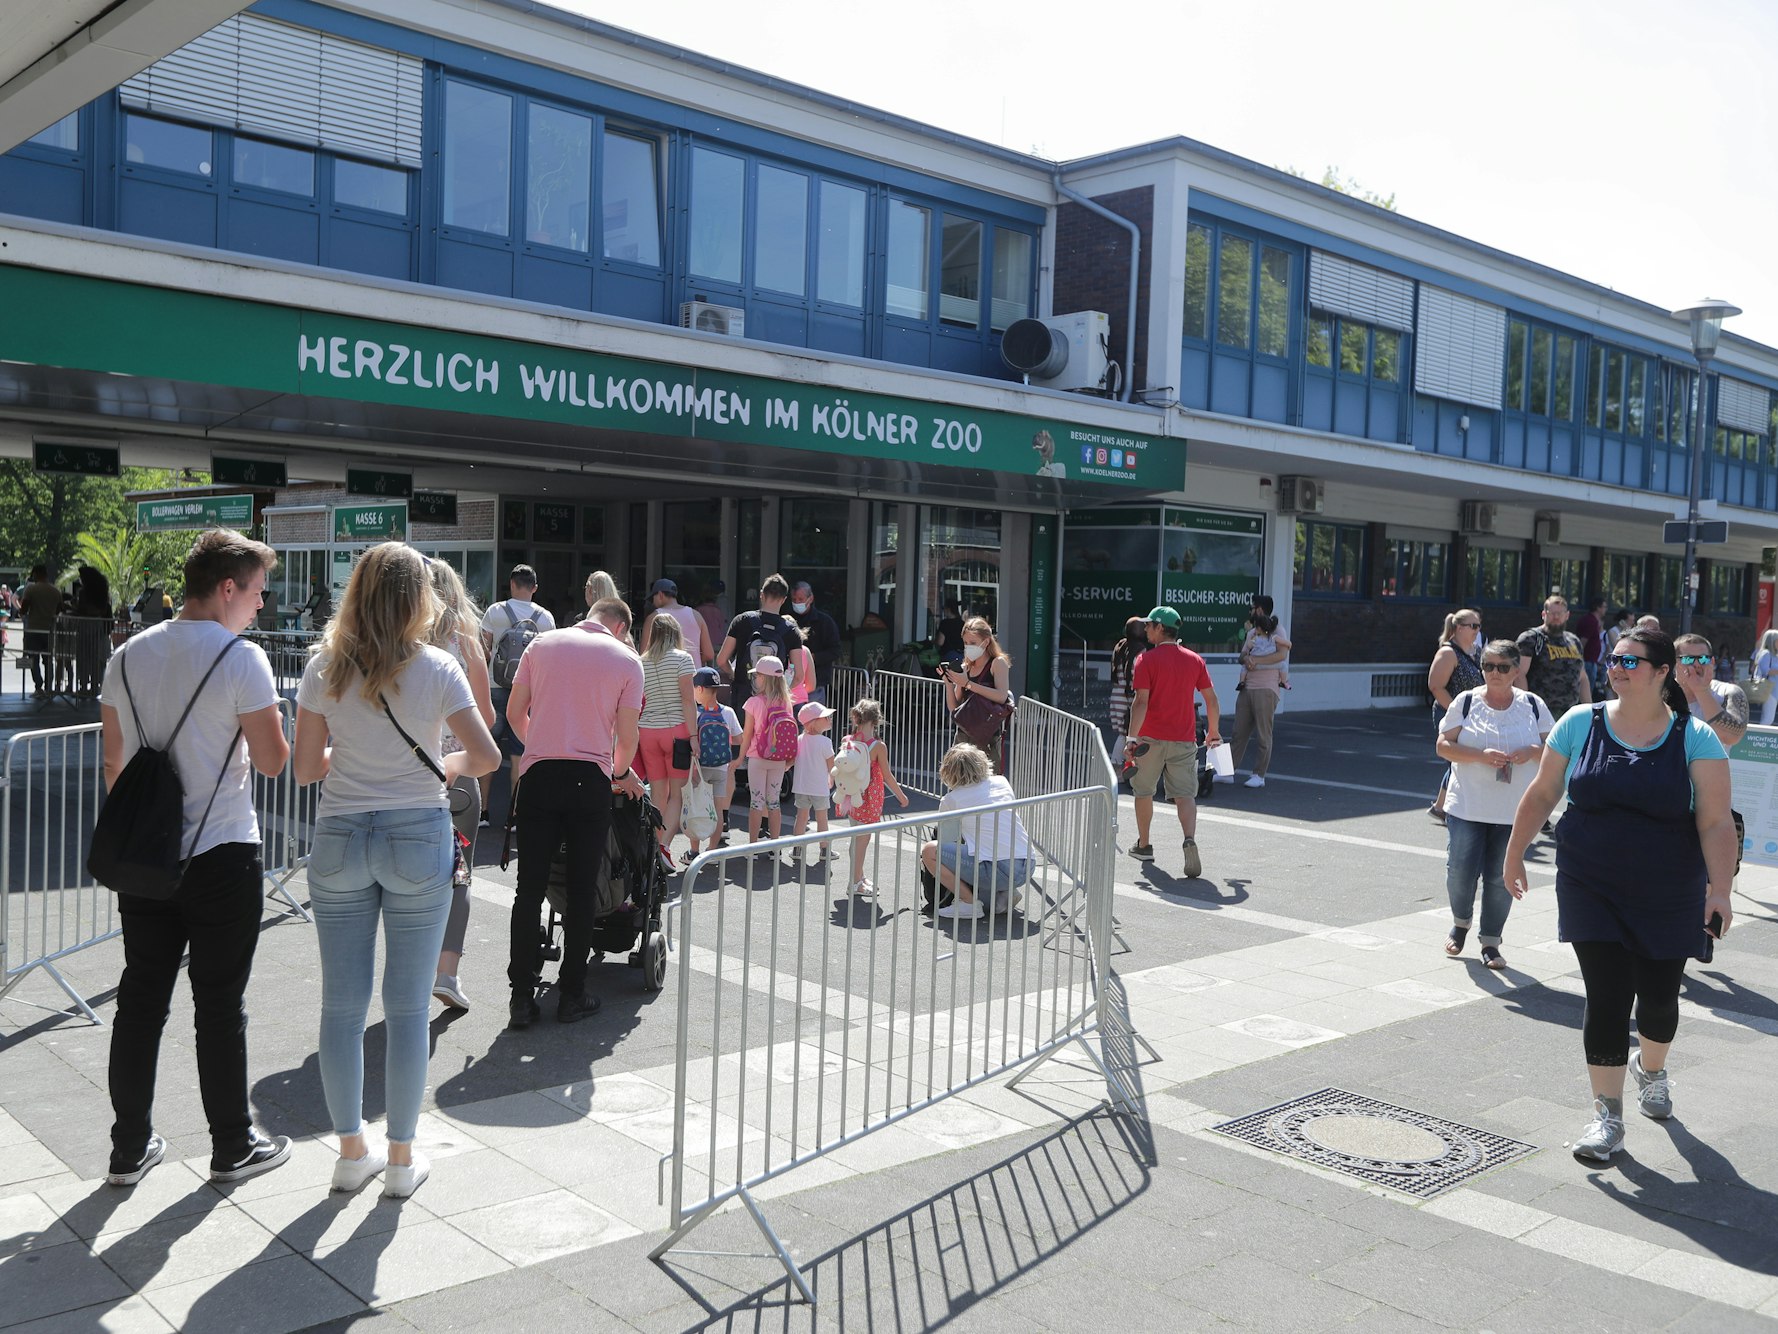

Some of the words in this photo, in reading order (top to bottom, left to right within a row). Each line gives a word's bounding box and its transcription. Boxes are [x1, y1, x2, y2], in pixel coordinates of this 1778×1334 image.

[298, 333, 500, 395] HERZLICH
[519, 363, 751, 427] WILLKOMMEN
[765, 397, 799, 433] IM
[812, 398, 919, 445] KÖLNER
[931, 417, 982, 454] ZOO
[1070, 430, 1101, 443] BESUCHT
[1101, 435, 1115, 446] UNS
[1116, 437, 1135, 448] AUCH
[1135, 440, 1149, 450] AUF
[1080, 467, 1137, 480] WWW.KOELNERZOO.DE
[419, 495, 446, 505] KASSE
[429, 505, 436, 514] 6
[539, 507, 569, 519] KASSE
[355, 511, 377, 525] KASSE
[378, 511, 384, 525] 6
[550, 519, 559, 531] 5
[1182, 615, 1207, 624] HERZLICH
[1207, 616, 1238, 624] WILLKOMMEN
[1747, 735, 1778, 743] WICHTIGE
